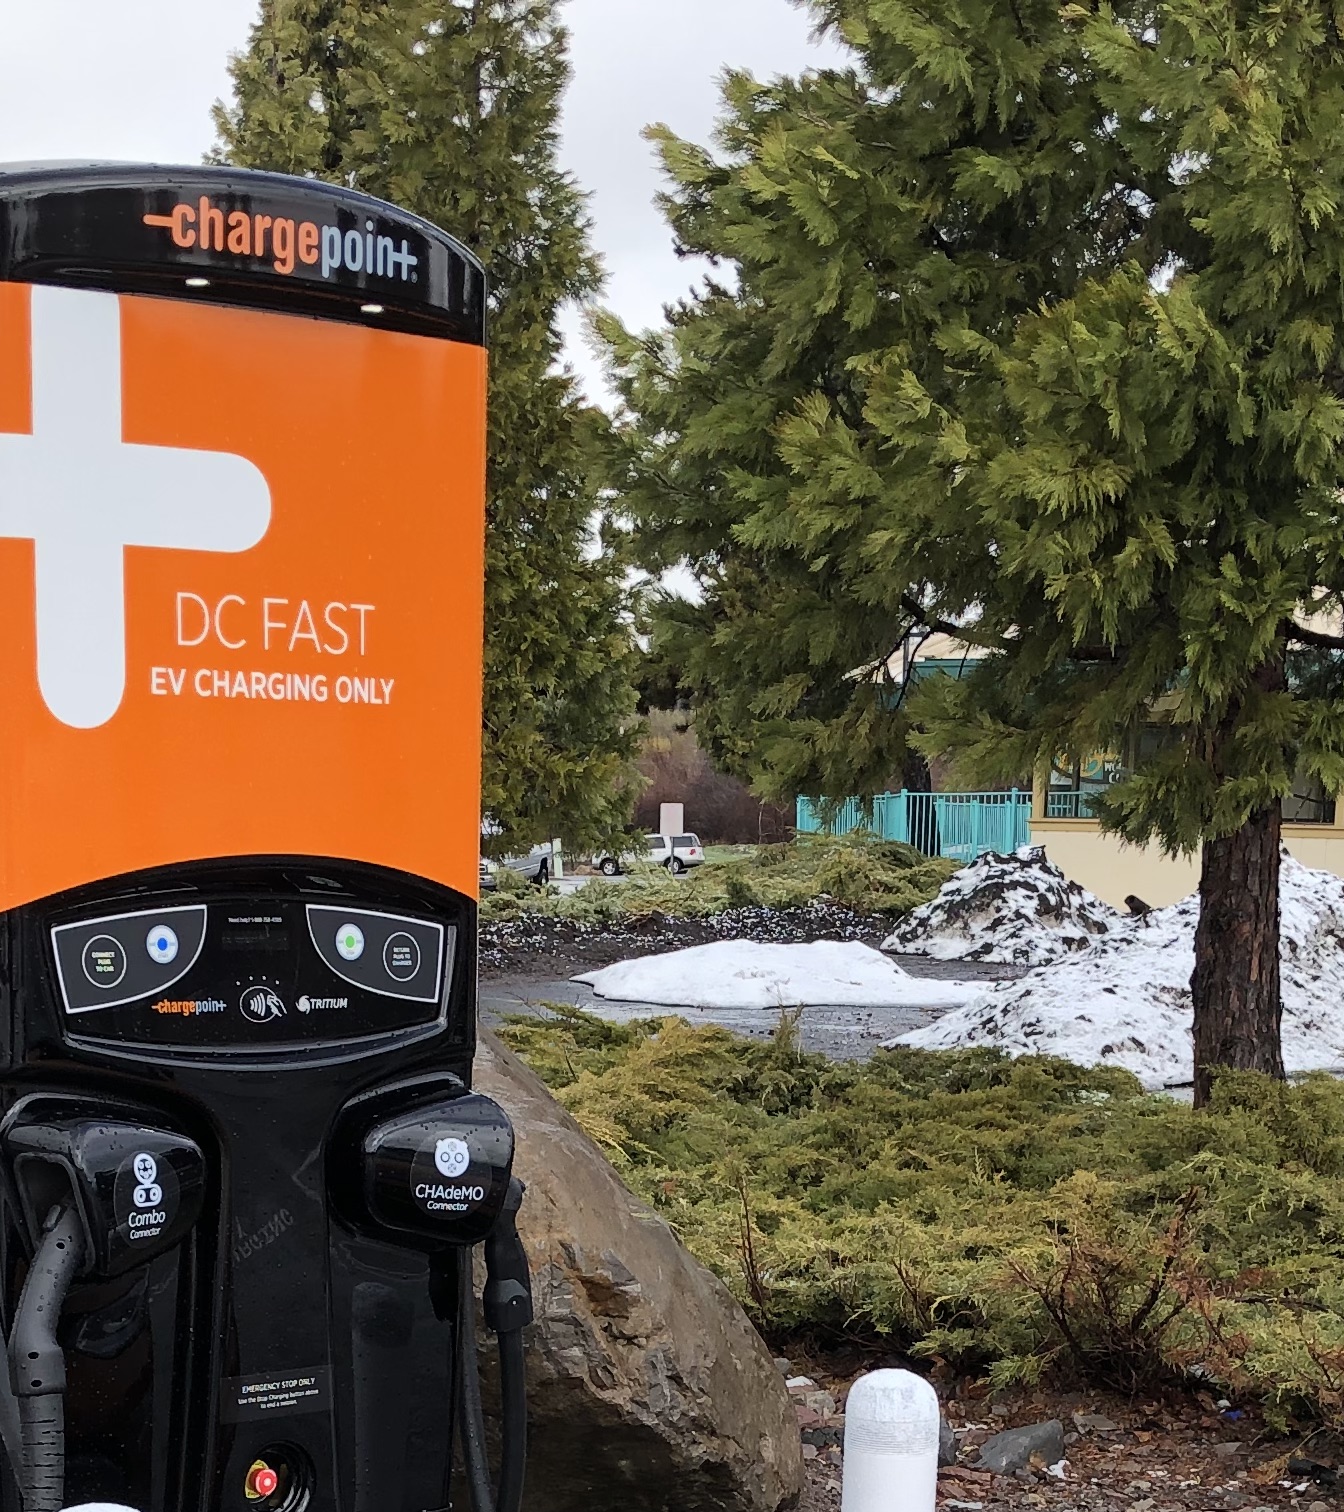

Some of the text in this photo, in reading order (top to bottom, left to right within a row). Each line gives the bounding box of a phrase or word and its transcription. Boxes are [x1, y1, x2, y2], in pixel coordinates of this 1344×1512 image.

[143, 196, 418, 280] chargepoint
[176, 592, 375, 655] DC FAST
[151, 666, 394, 705] EV CHARGING ONLY
[311, 998, 348, 1009] TRITIUM
[416, 1184, 484, 1200] CHAdeMO
[427, 1201, 469, 1211] Connector
[128, 1209, 166, 1227] Combo
[130, 1228, 161, 1239] Connector
[242, 1378, 315, 1393] EMERGENCY STOP ONLY
